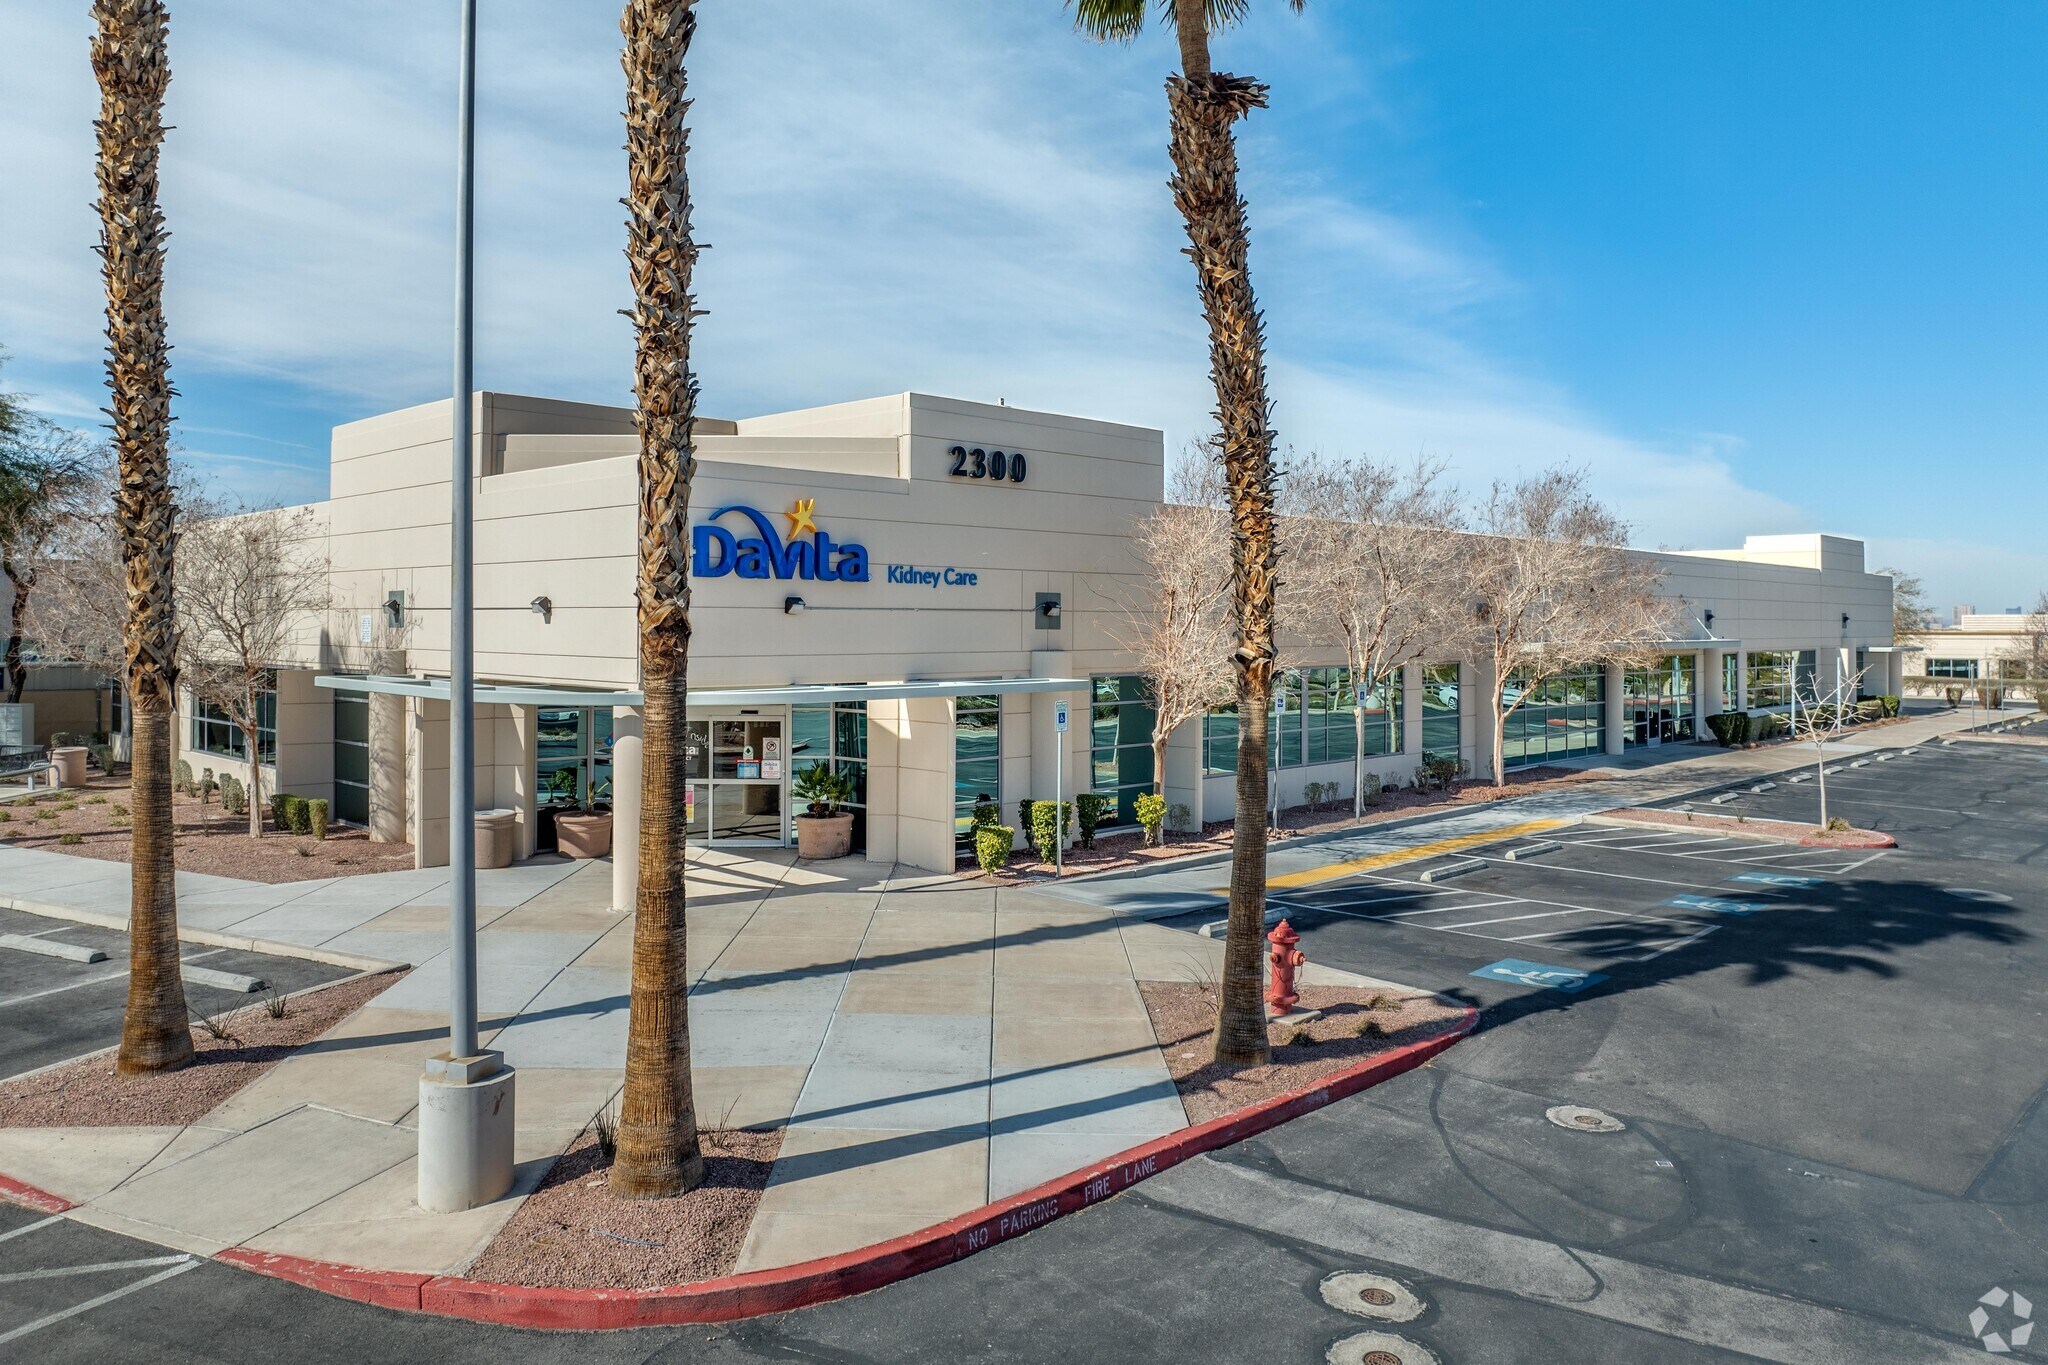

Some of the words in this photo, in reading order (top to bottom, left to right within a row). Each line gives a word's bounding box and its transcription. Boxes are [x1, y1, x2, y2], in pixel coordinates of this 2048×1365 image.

[949, 446, 1026, 483] 2300
[692, 503, 869, 582] DaVita
[887, 564, 941, 588] Kidney
[943, 567, 978, 586] Care
[968, 1227, 988, 1251] NO
[1000, 1200, 1059, 1237] PARKING
[1084, 1177, 1112, 1203] FIRE
[1125, 1156, 1157, 1183] LANE
